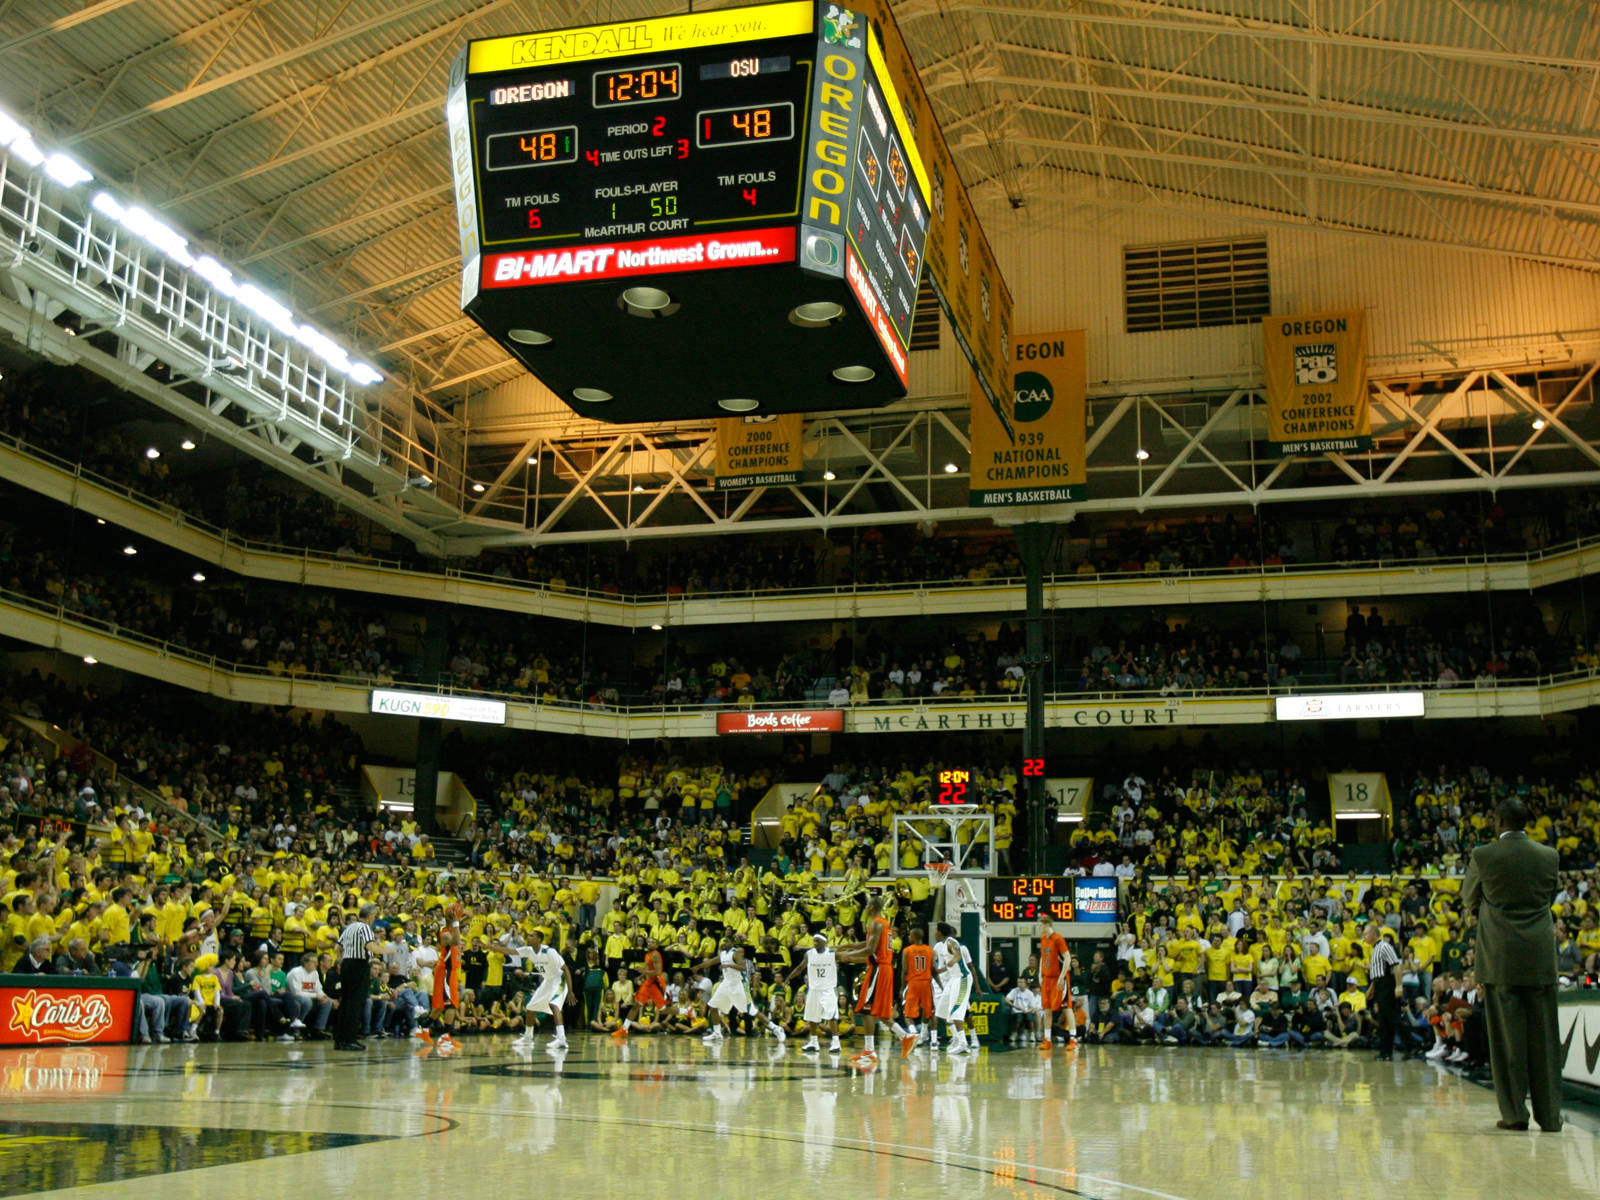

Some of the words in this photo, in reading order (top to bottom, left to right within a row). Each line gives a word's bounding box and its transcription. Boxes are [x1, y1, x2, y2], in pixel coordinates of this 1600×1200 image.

[512, 24, 653, 65] KENDALL
[663, 26, 686, 42] We
[692, 22, 728, 40] hear
[732, 19, 767, 38] you.
[731, 58, 759, 77] OSU
[494, 80, 569, 105] OREGON
[608, 69, 677, 101] 12:04
[607, 123, 648, 137] PERIOD
[652, 116, 666, 136] 2
[733, 110, 771, 137] 48
[520, 133, 556, 160] 48
[600, 150, 620, 163] TIME
[623, 148, 648, 161] OUTS
[651, 145, 673, 158] LEFT
[677, 139, 690, 159] 3
[585, 149, 600, 167] 4
[717, 175, 734, 186] TM
[738, 171, 776, 183] FOULS
[595, 181, 679, 199] FOULS-PLAYER
[742, 188, 757, 206] 4
[505, 197, 521, 208] TM
[524, 193, 560, 205] FOULS
[650, 196, 677, 217] 50
[528, 208, 542, 229] 6
[585, 223, 646, 238] McARTHUR
[649, 218, 689, 232] COURT
[618, 243, 704, 268] Northwest
[1281, 318, 1347, 336] OREGON
[1016, 341, 1064, 360] EGON
[1303, 393, 1332, 405] 2002
[1281, 405, 1356, 421] CONFERENCE
[1283, 418, 1354, 434] CHAMPIONS
[747, 431, 772, 442] 2000
[1018, 432, 1044, 446] 939
[728, 442, 790, 456] CONFERENCE
[1282, 443, 1308, 453] MEN'S
[1310, 439, 1358, 450] BASKETBALL
[728, 456, 789, 470] CHAMPIONS
[994, 447, 1062, 464] NATIONAL
[720, 477, 754, 487] WOMEN'S
[756, 474, 797, 484] BASKETBALL
[987, 463, 1069, 481] CHAMPIONS
[984, 493, 1013, 504] MEN'S
[1016, 489, 1071, 502] BASKETBALL
[379, 698, 421, 713] KUGN
[423, 702, 450, 716] 590
[1167, 699, 1180, 707] 224
[1074, 709, 1177, 725] COURT
[1023, 759, 1045, 776] 22
[939, 771, 970, 783] 12:04
[939, 784, 966, 804] 22
[1057, 788, 1079, 805] 17
[1345, 783, 1368, 802] 18
[1013, 879, 1054, 895] 12:04
[993, 903, 1014, 919] 48
[1025, 903, 1036, 918] 2
[1051, 903, 1072, 919] 48
[914, 956, 926, 971] 11
[816, 968, 826, 978] 12
[31, 999, 82, 1027] Carl's
[82, 999, 110, 1026] Jr.
[969, 1001, 1000, 1014] ART
